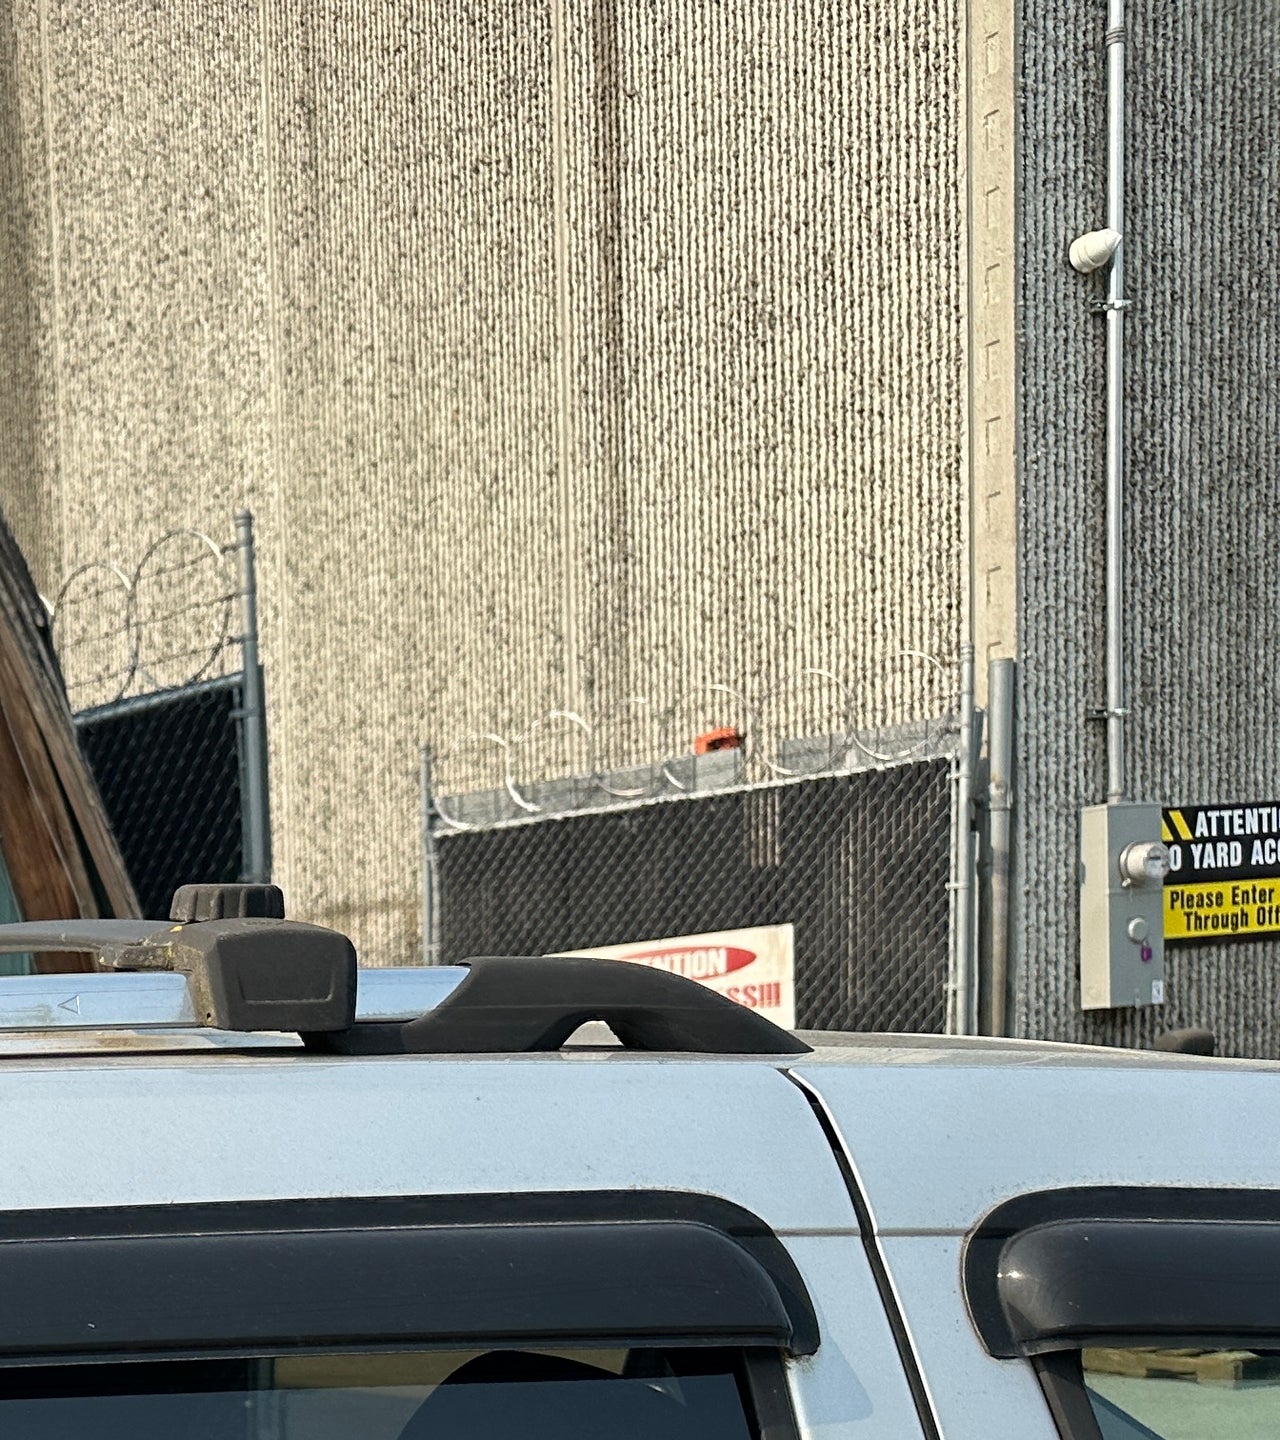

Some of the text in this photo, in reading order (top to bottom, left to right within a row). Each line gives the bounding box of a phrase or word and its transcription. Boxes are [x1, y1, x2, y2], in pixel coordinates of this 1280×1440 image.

[1195, 806, 1280, 838] ATTENTI
[1169, 838, 1280, 872] O YARD AC
[1170, 884, 1275, 910] Please Enter
[1184, 909, 1249, 932] Through
